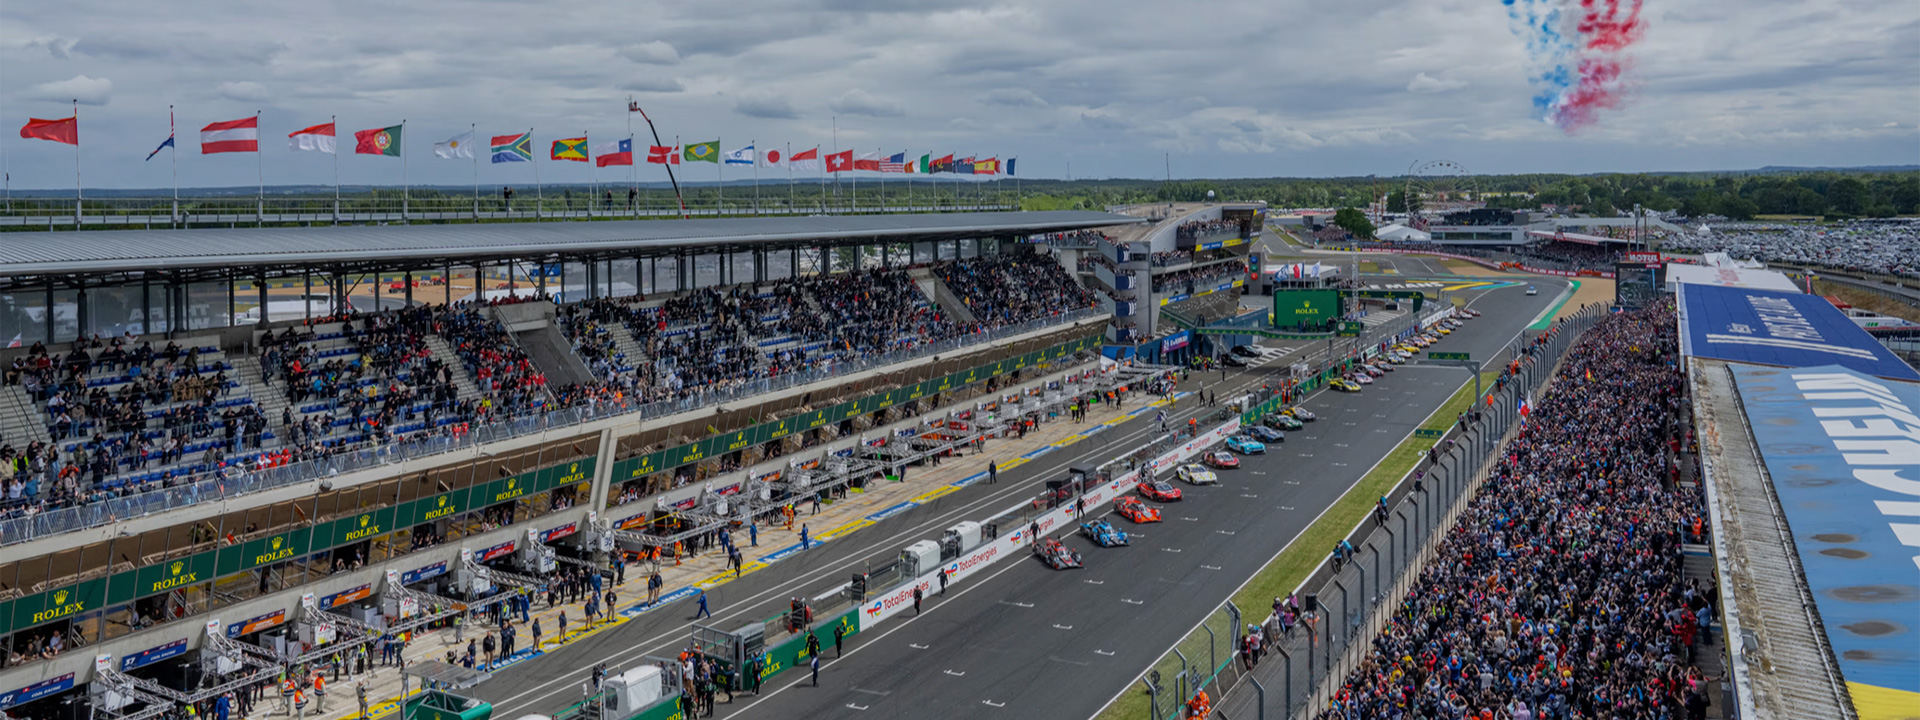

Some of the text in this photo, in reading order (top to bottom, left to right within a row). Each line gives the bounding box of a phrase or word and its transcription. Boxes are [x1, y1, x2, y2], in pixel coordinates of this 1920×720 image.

[1630, 254, 1658, 262] MOTUL
[910, 391, 923, 399] ROLEX
[879, 399, 893, 408] ROLEX
[846, 408, 861, 417] ROLEX
[810, 417, 826, 428] ROLEX
[771, 428, 789, 439] ROLEX
[729, 439, 748, 450] ROLEX
[683, 451, 704, 463] ROLEX
[632, 464, 654, 477] ROLEX
[1791, 373, 1920, 570] CHELIN
[560, 471, 584, 485] ROLEX
[496, 487, 523, 502] ROLEX
[1074, 493, 1102, 511] TEnergies
[425, 504, 455, 520] ROLEX
[345, 524, 380, 541] ROLEX
[256, 547, 294, 565] ROLEX
[958, 546, 997, 572] TotalEnergies
[152, 571, 197, 592] ROLEX
[883, 581, 929, 610] TotalEneies
[323, 598, 330, 606] 91
[32, 600, 84, 624] ROLEX
[230, 625, 240, 634] 92
[162, 649, 176, 658] RACING
[124, 656, 136, 666] 37
[31, 685, 61, 698] COOL RACING
[2, 694, 13, 704] 47
